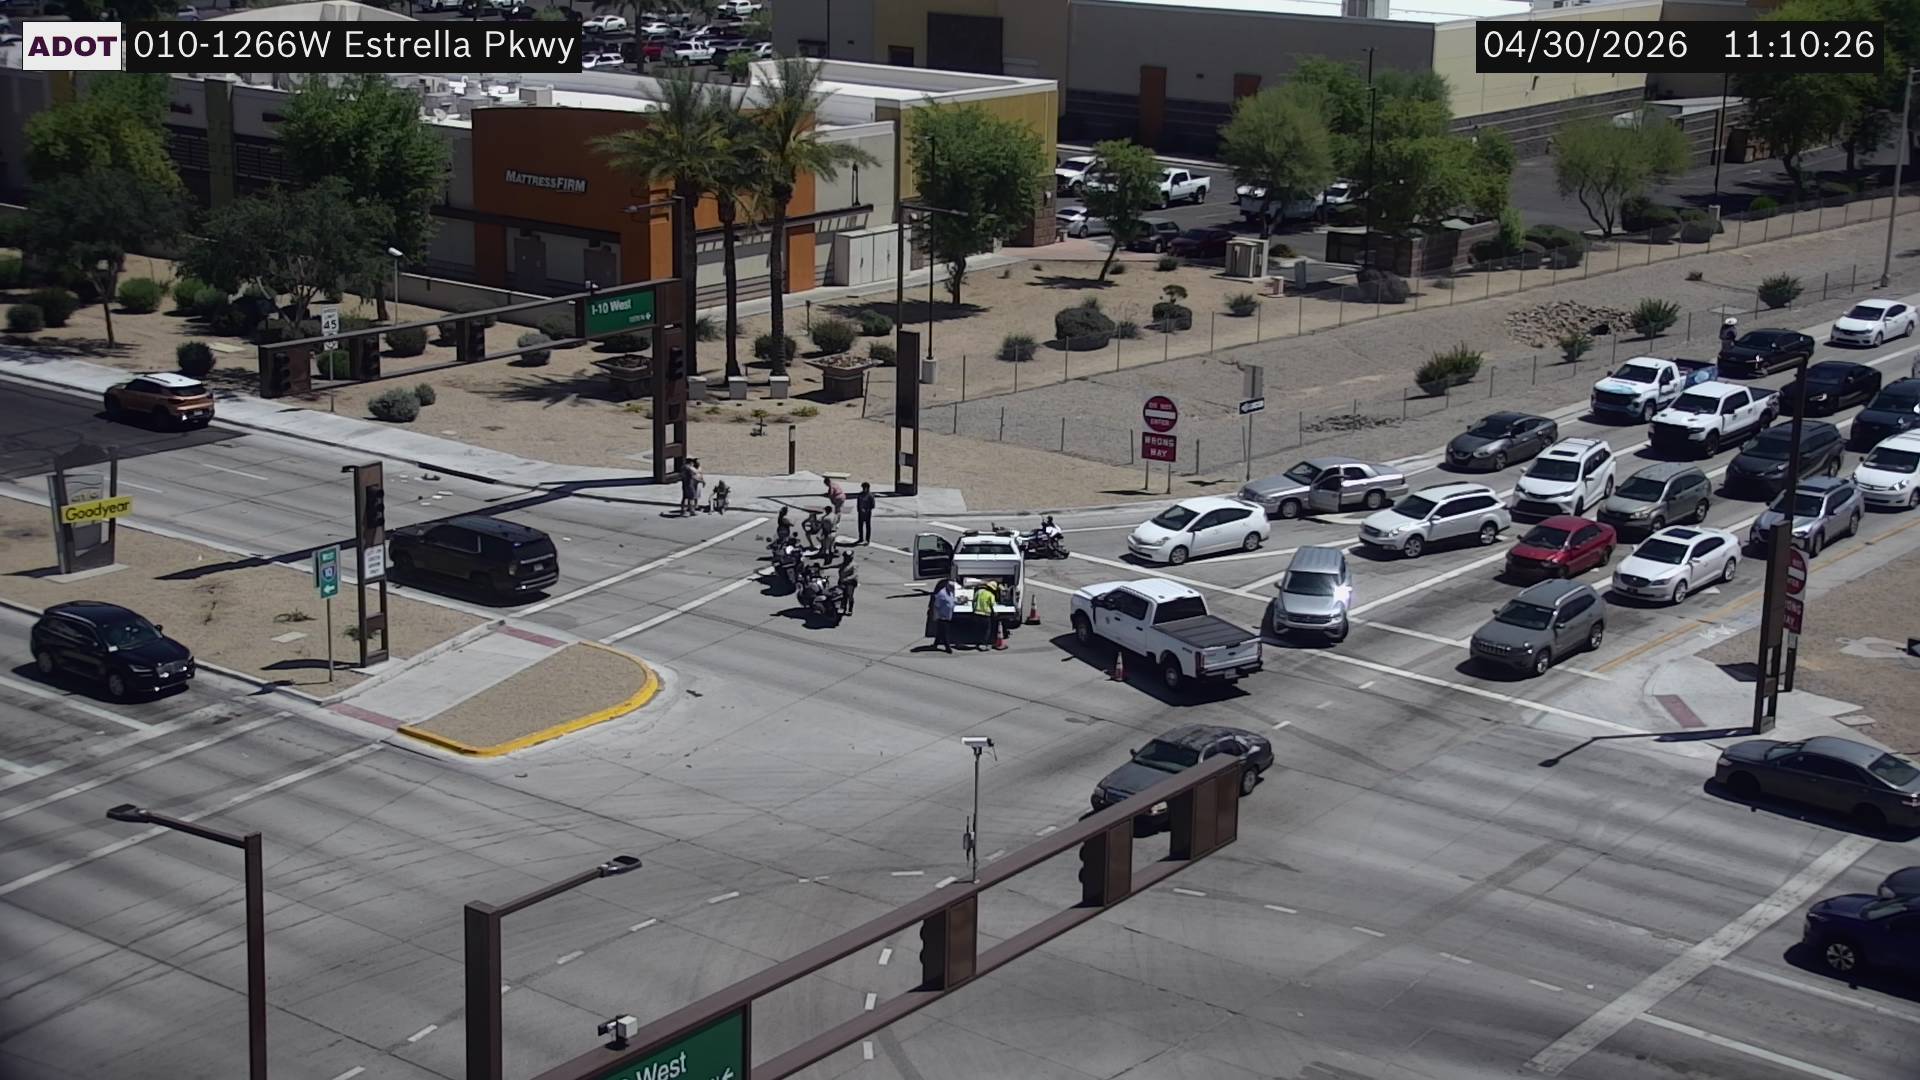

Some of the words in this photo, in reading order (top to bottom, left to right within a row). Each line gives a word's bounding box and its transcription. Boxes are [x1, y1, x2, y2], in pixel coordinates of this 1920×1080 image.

[592, 302, 609, 315] I-10
[610, 299, 632, 312] West
[324, 320, 337, 329] 45
[65, 501, 130, 521] Goodyear
[636, 1051, 687, 1080] West
